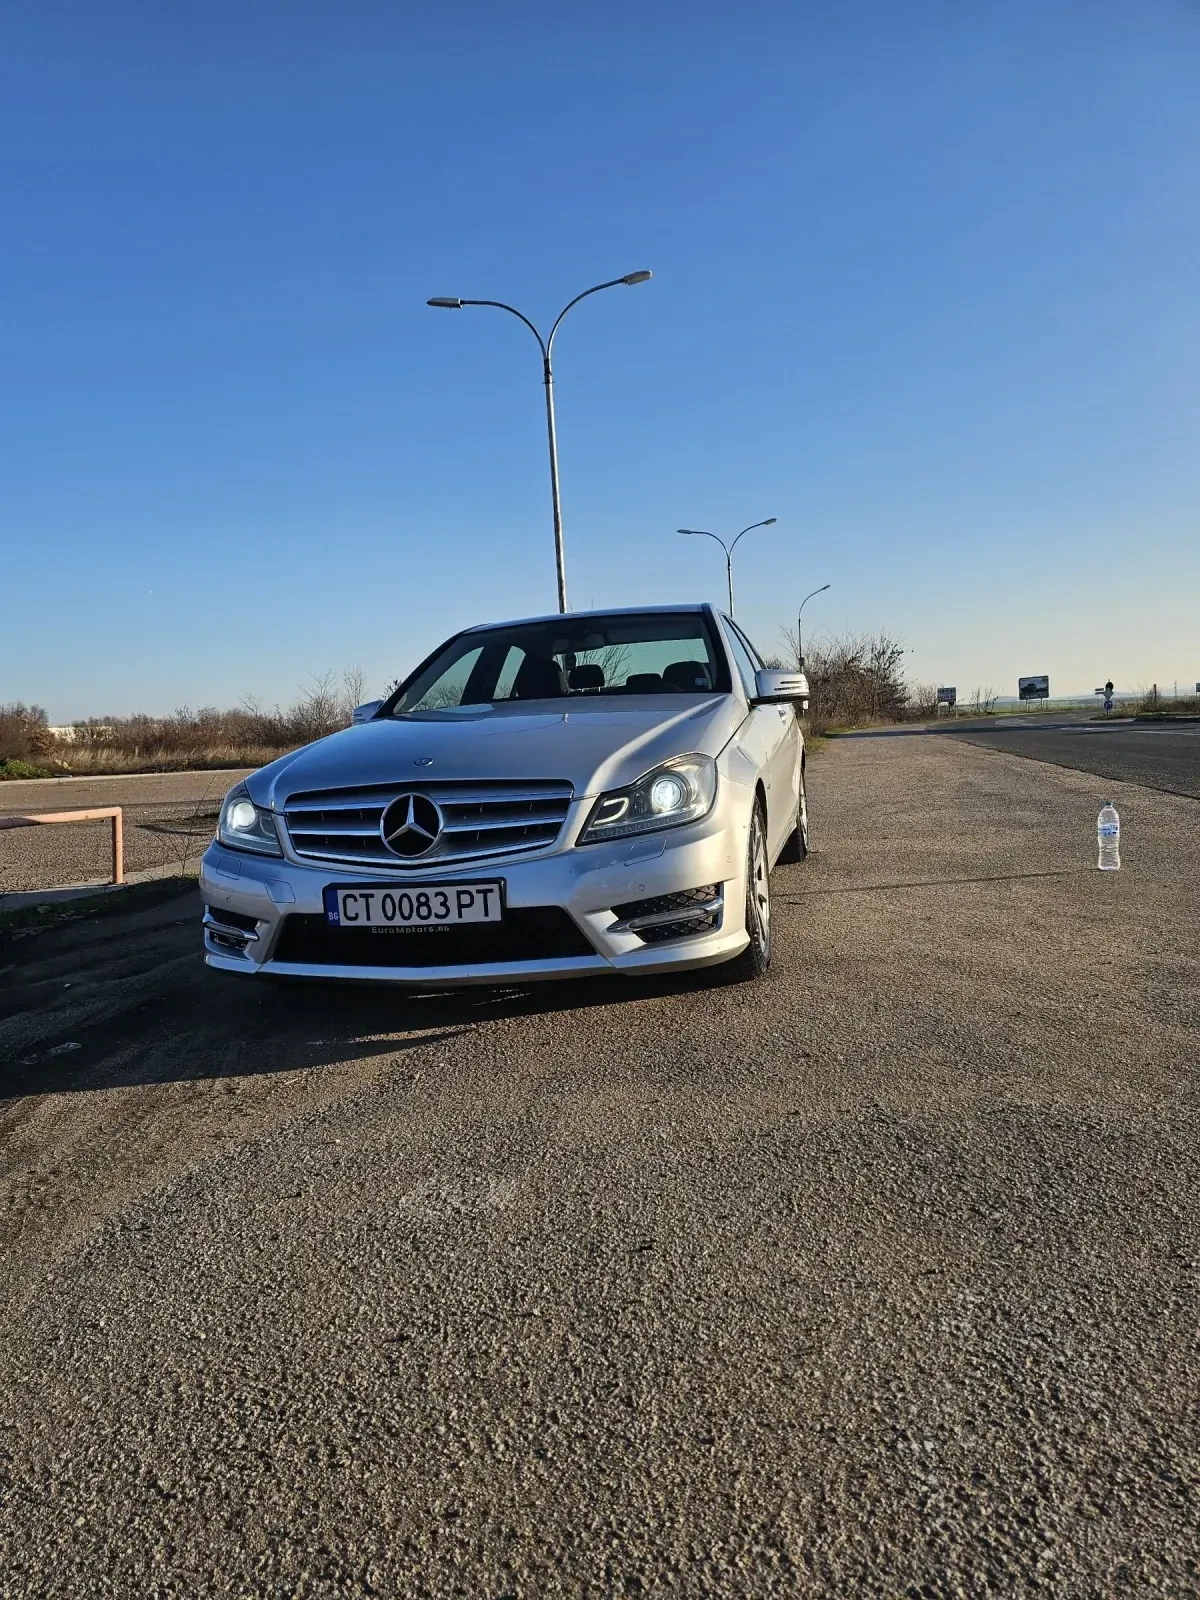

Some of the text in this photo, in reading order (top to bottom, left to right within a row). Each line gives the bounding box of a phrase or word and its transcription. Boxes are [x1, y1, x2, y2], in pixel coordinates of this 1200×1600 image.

[342, 888, 494, 921] CT 0083 PT
[328, 911, 339, 920] BG
